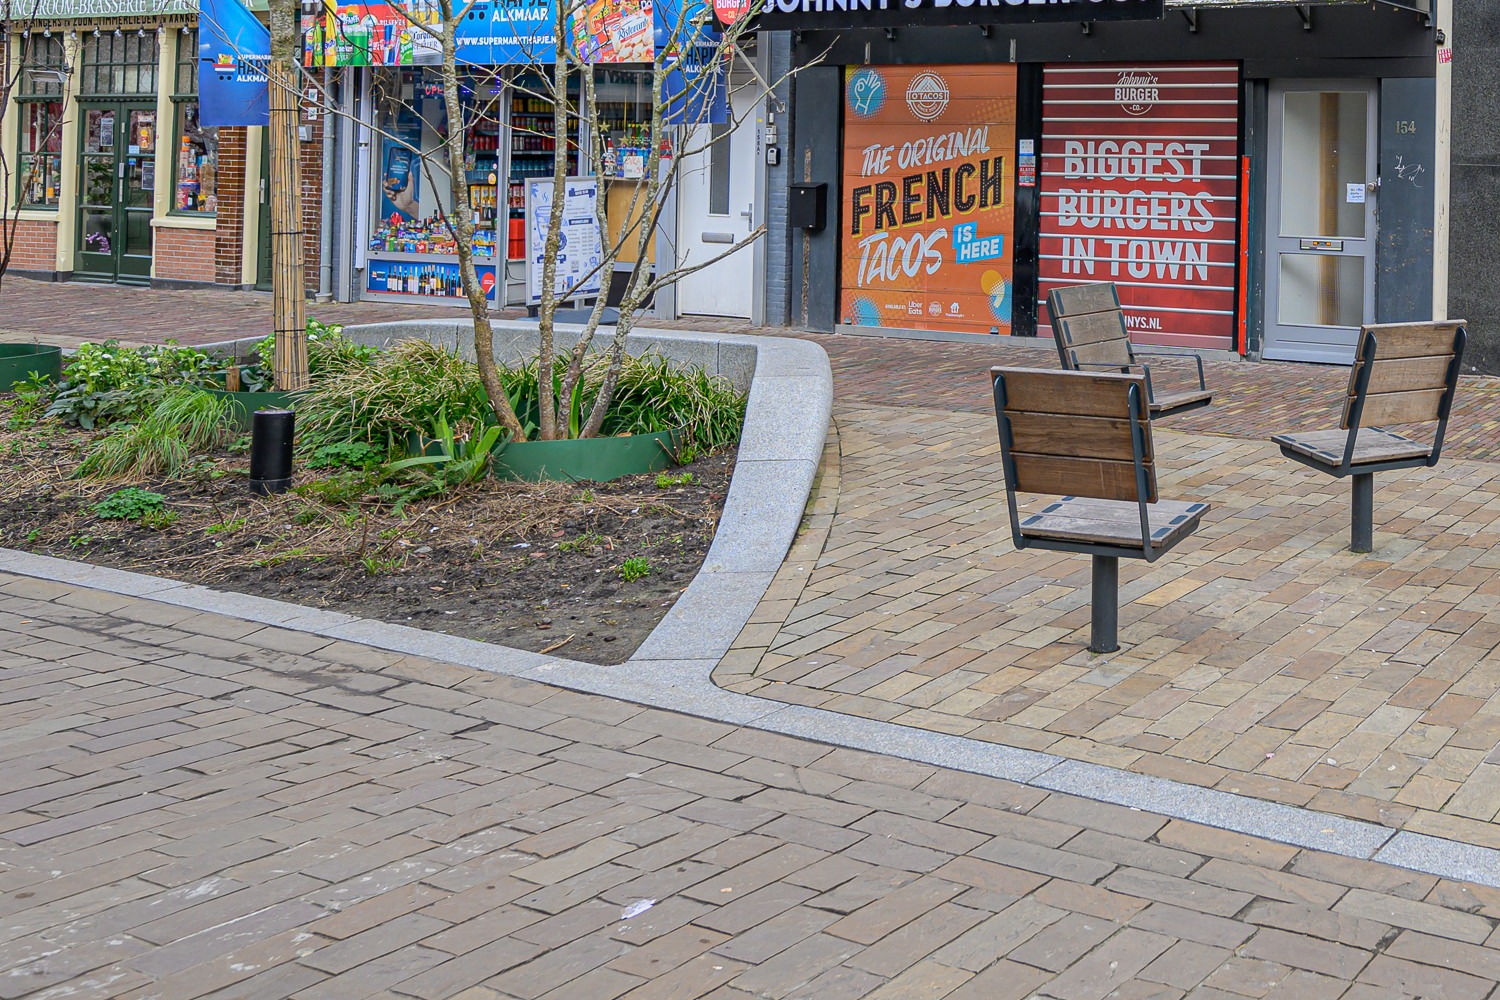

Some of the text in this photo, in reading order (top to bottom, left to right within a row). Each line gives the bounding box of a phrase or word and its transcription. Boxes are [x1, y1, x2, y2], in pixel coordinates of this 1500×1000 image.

[491, 8, 550, 23] ALKMAAR
[455, 34, 558, 47] WWW.SUPERMARKTHAPJE.N
[237, 53, 272, 61] SUPERMARK
[1114, 88, 1159, 101] BURGER
[1395, 120, 1417, 135] 154
[861, 125, 991, 178] THE ORIGINAL
[1064, 140, 1210, 183] BIGGEST
[851, 156, 1004, 237] FRENCH
[1057, 187, 1215, 233] BURGERS
[957, 225, 973, 244] IS
[857, 227, 948, 288] TACOS
[960, 237, 1000, 261] HERE
[1061, 237, 1209, 281] IN TOWN
